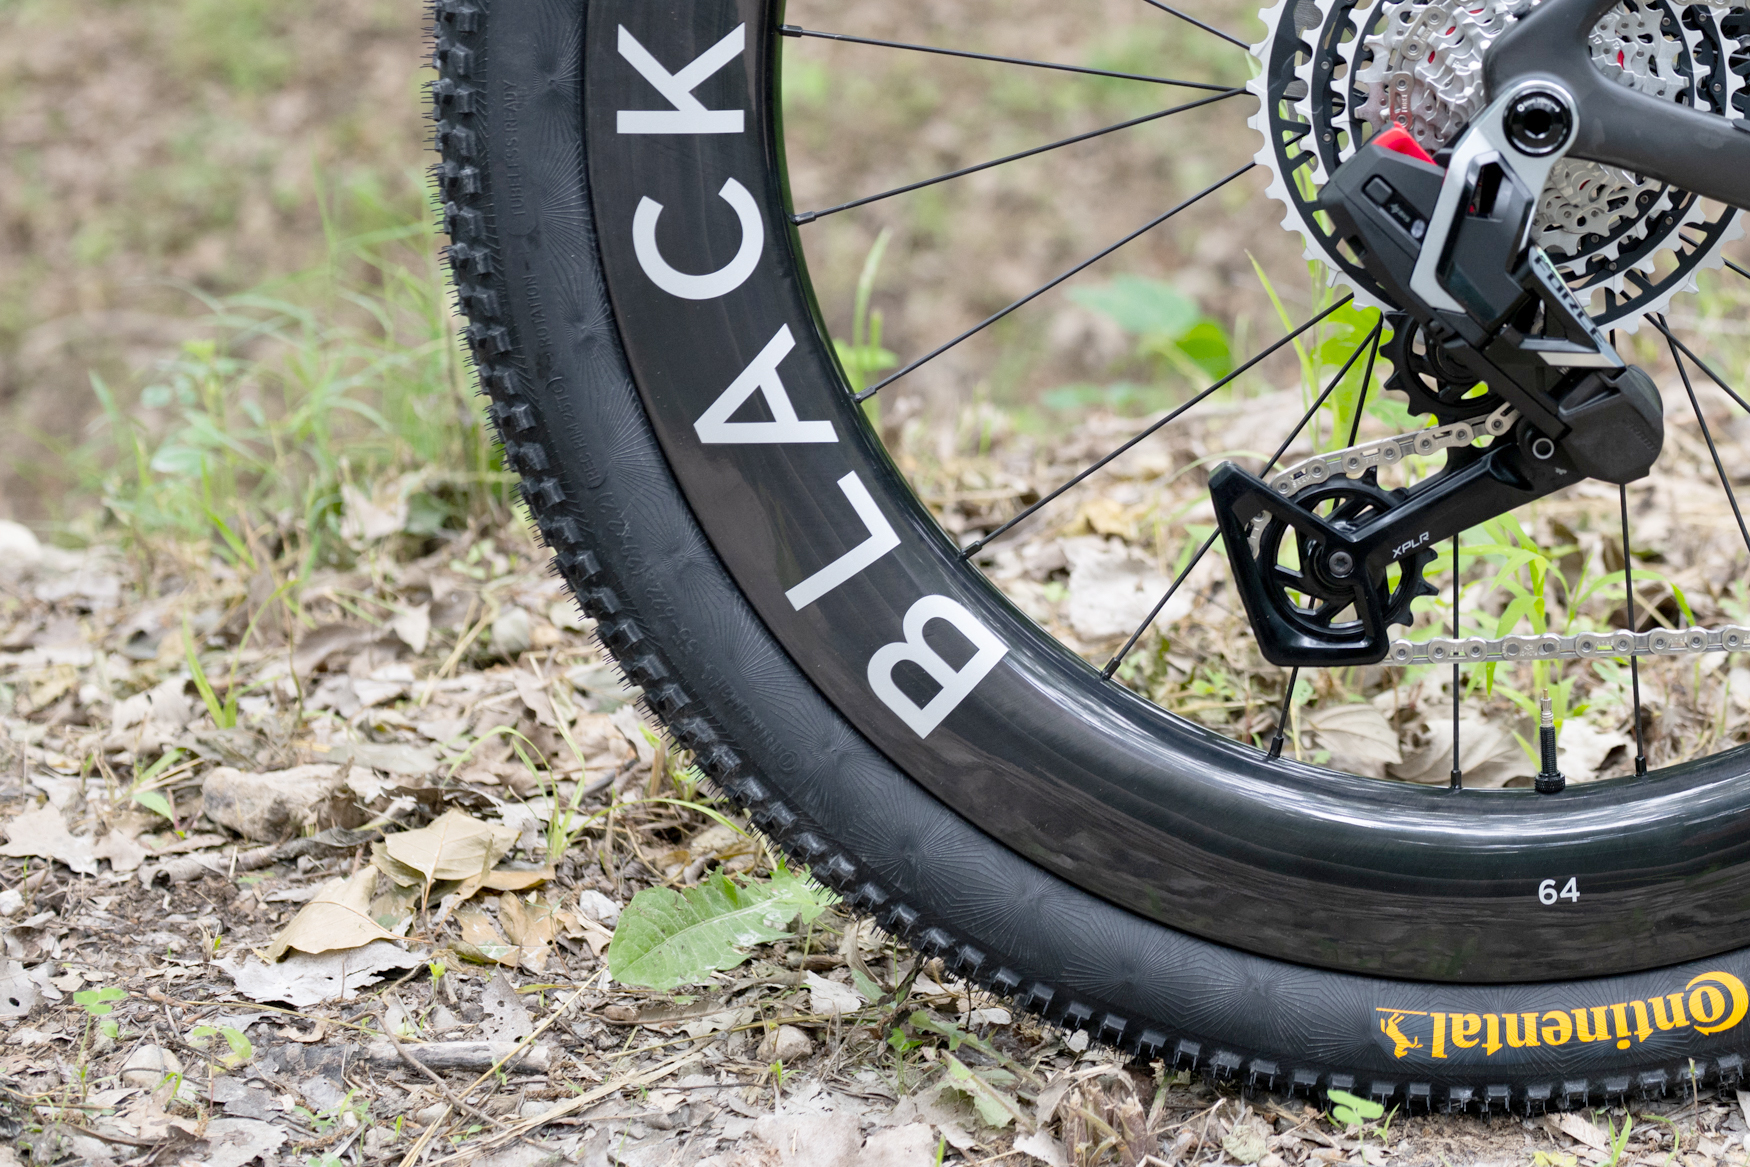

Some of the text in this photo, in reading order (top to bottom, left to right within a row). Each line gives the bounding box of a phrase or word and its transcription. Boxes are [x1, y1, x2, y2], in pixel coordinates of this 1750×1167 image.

[616, 21, 1009, 739] BLACK
[1391, 530, 1430, 559] XPLR
[1537, 876, 1581, 906] 64
[1429, 970, 1750, 1059] Continental
